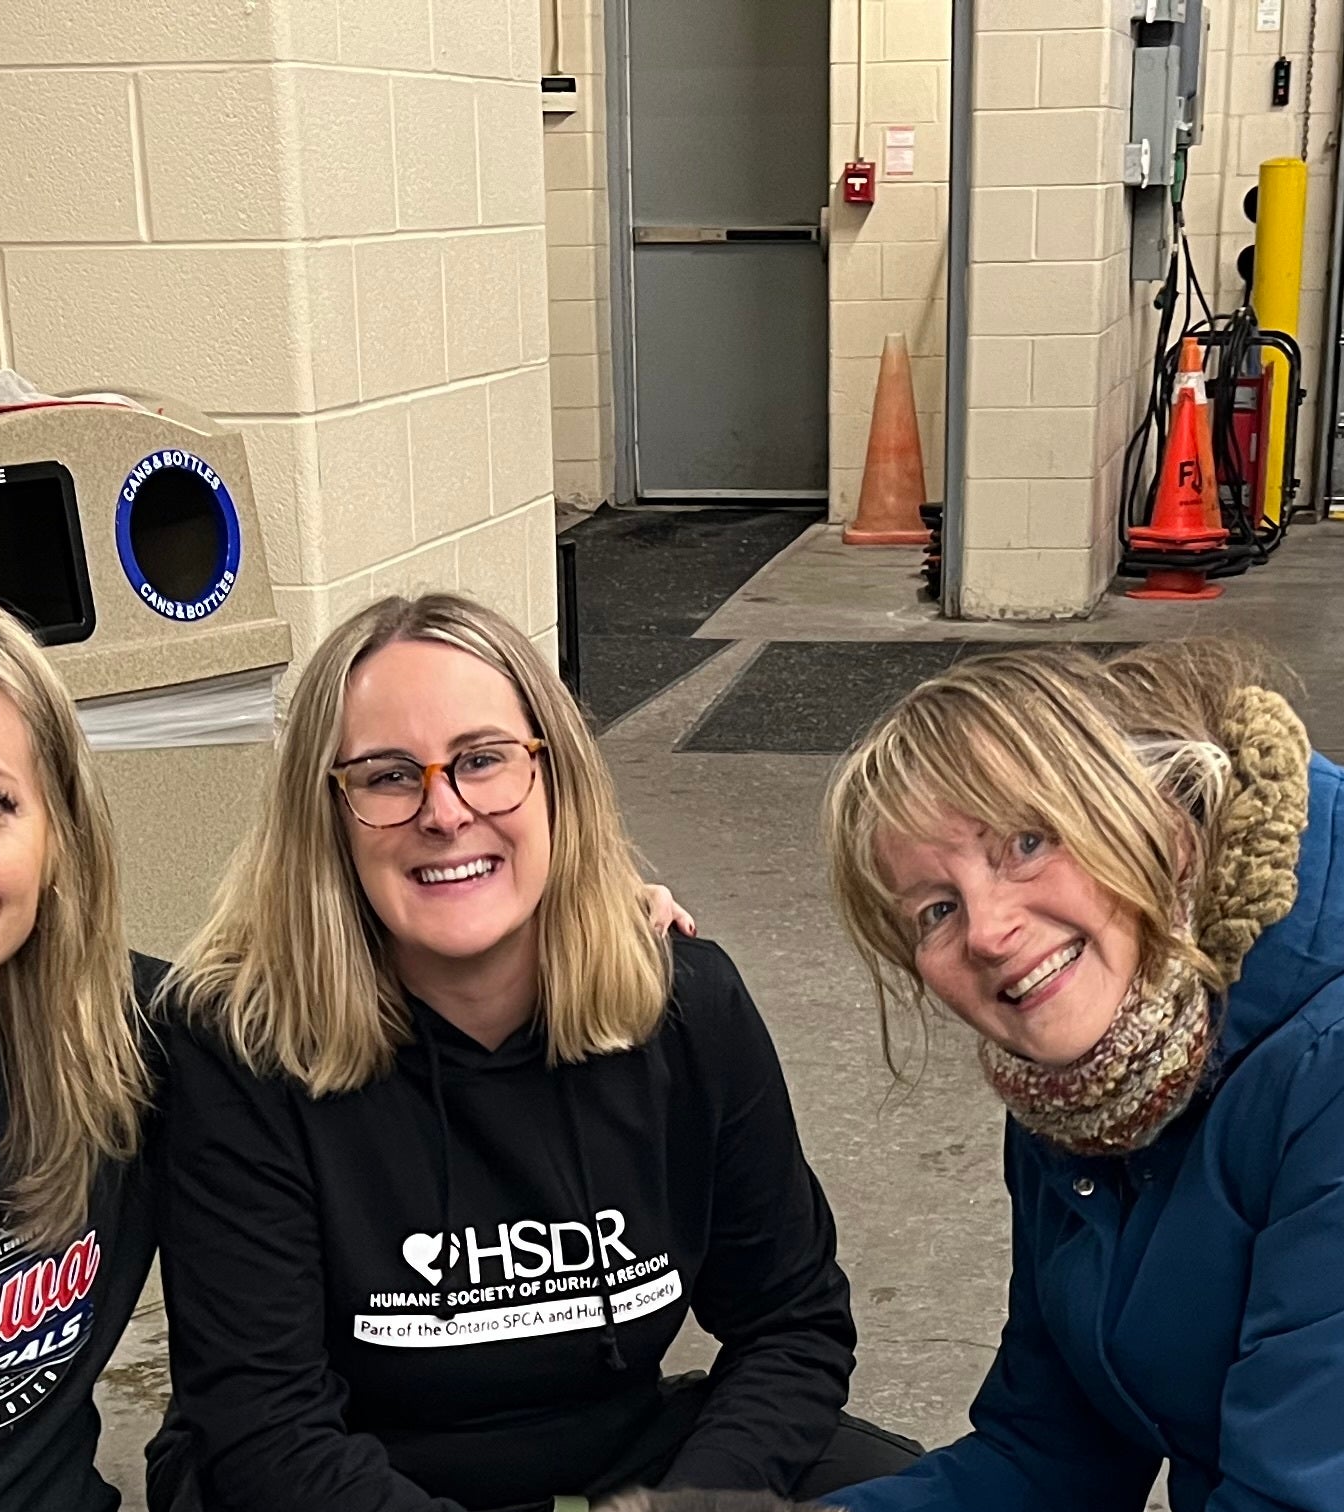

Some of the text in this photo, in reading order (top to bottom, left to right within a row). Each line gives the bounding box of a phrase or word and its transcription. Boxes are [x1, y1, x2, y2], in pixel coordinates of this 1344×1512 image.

[465, 1209, 637, 1284] HSDR
[369, 1252, 669, 1308] HUMANE SOCIETY OF DURHAM REGION
[361, 1320, 392, 1337] Part
[397, 1322, 412, 1337] of
[418, 1323, 442, 1337] the
[445, 1320, 499, 1336] Ontario
[503, 1311, 545, 1329] SPCA
[548, 1305, 573, 1323] and
[636, 1282, 675, 1308] Society
